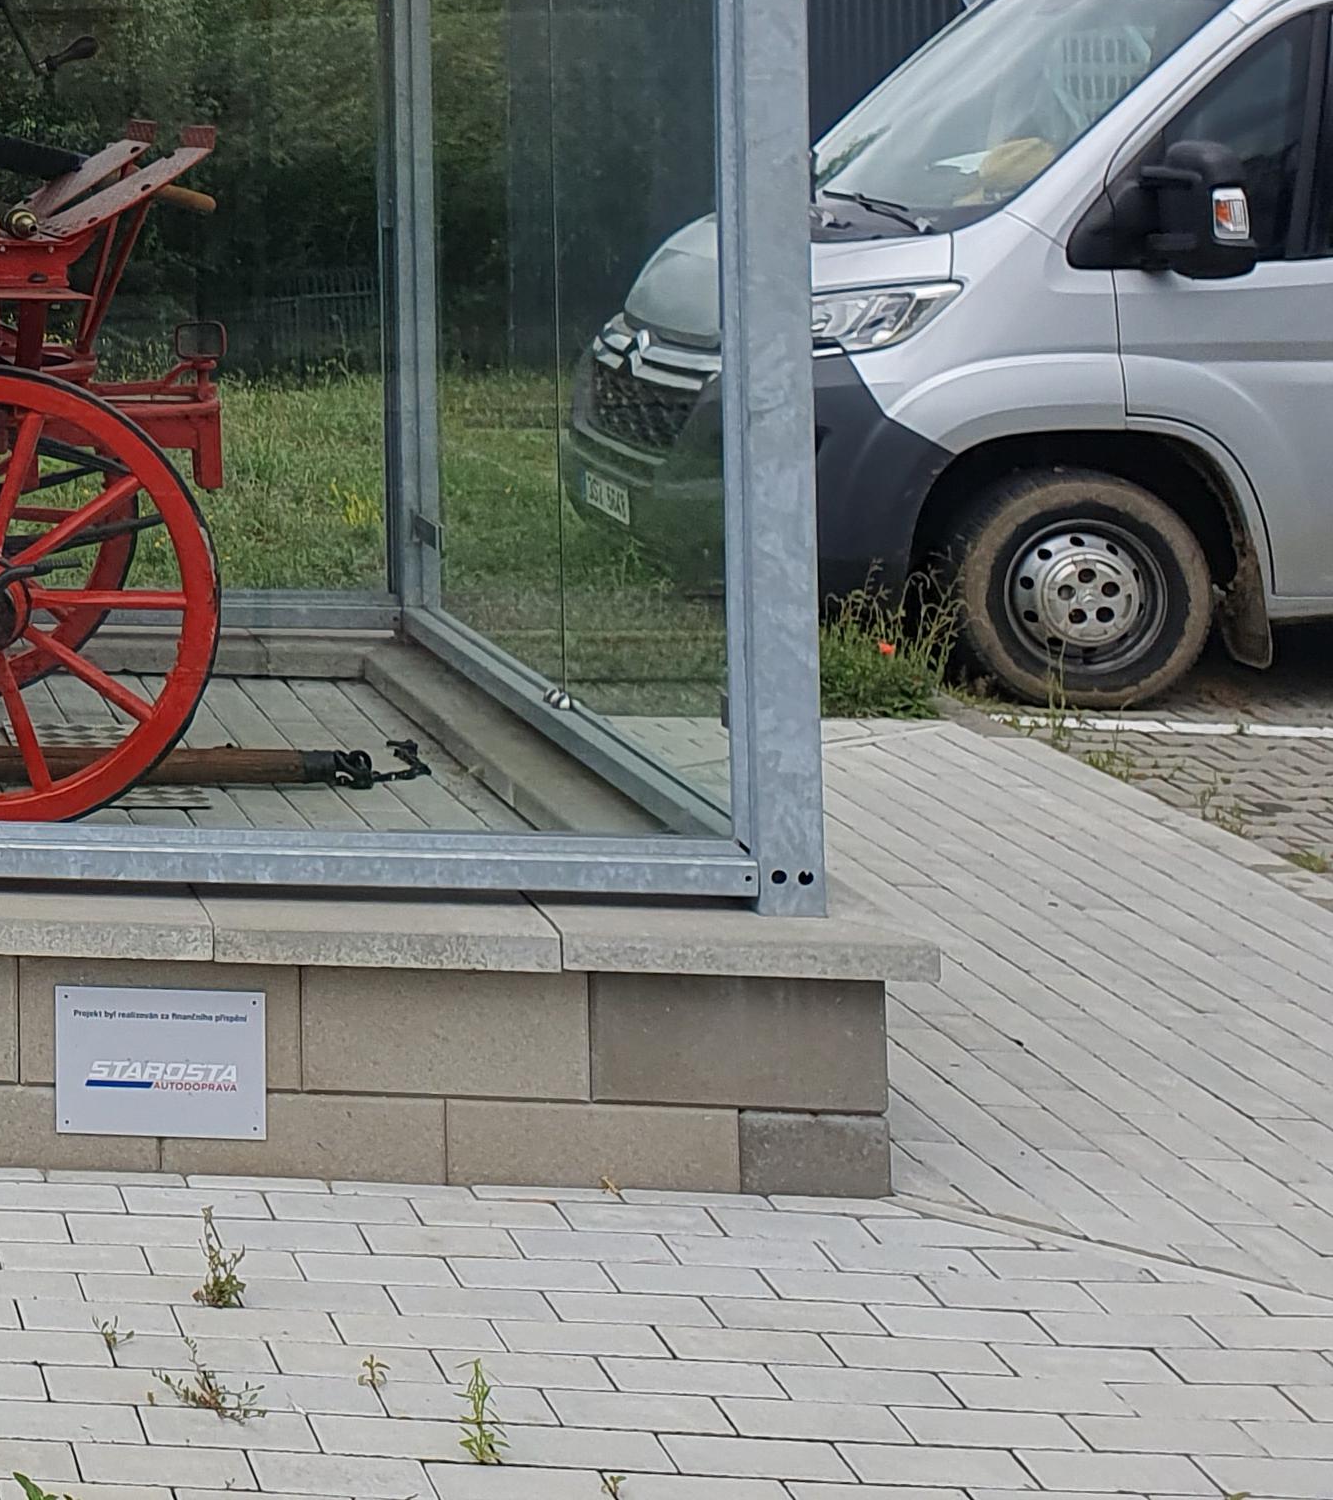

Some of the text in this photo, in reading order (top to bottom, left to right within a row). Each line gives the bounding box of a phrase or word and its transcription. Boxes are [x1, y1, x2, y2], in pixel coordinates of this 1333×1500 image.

[73, 1009, 102, 1017] Projekt
[104, 1010, 117, 1019] byl
[88, 1060, 237, 1082] STAROSTA
[153, 1081, 237, 1092] AUTODOPRAVA
